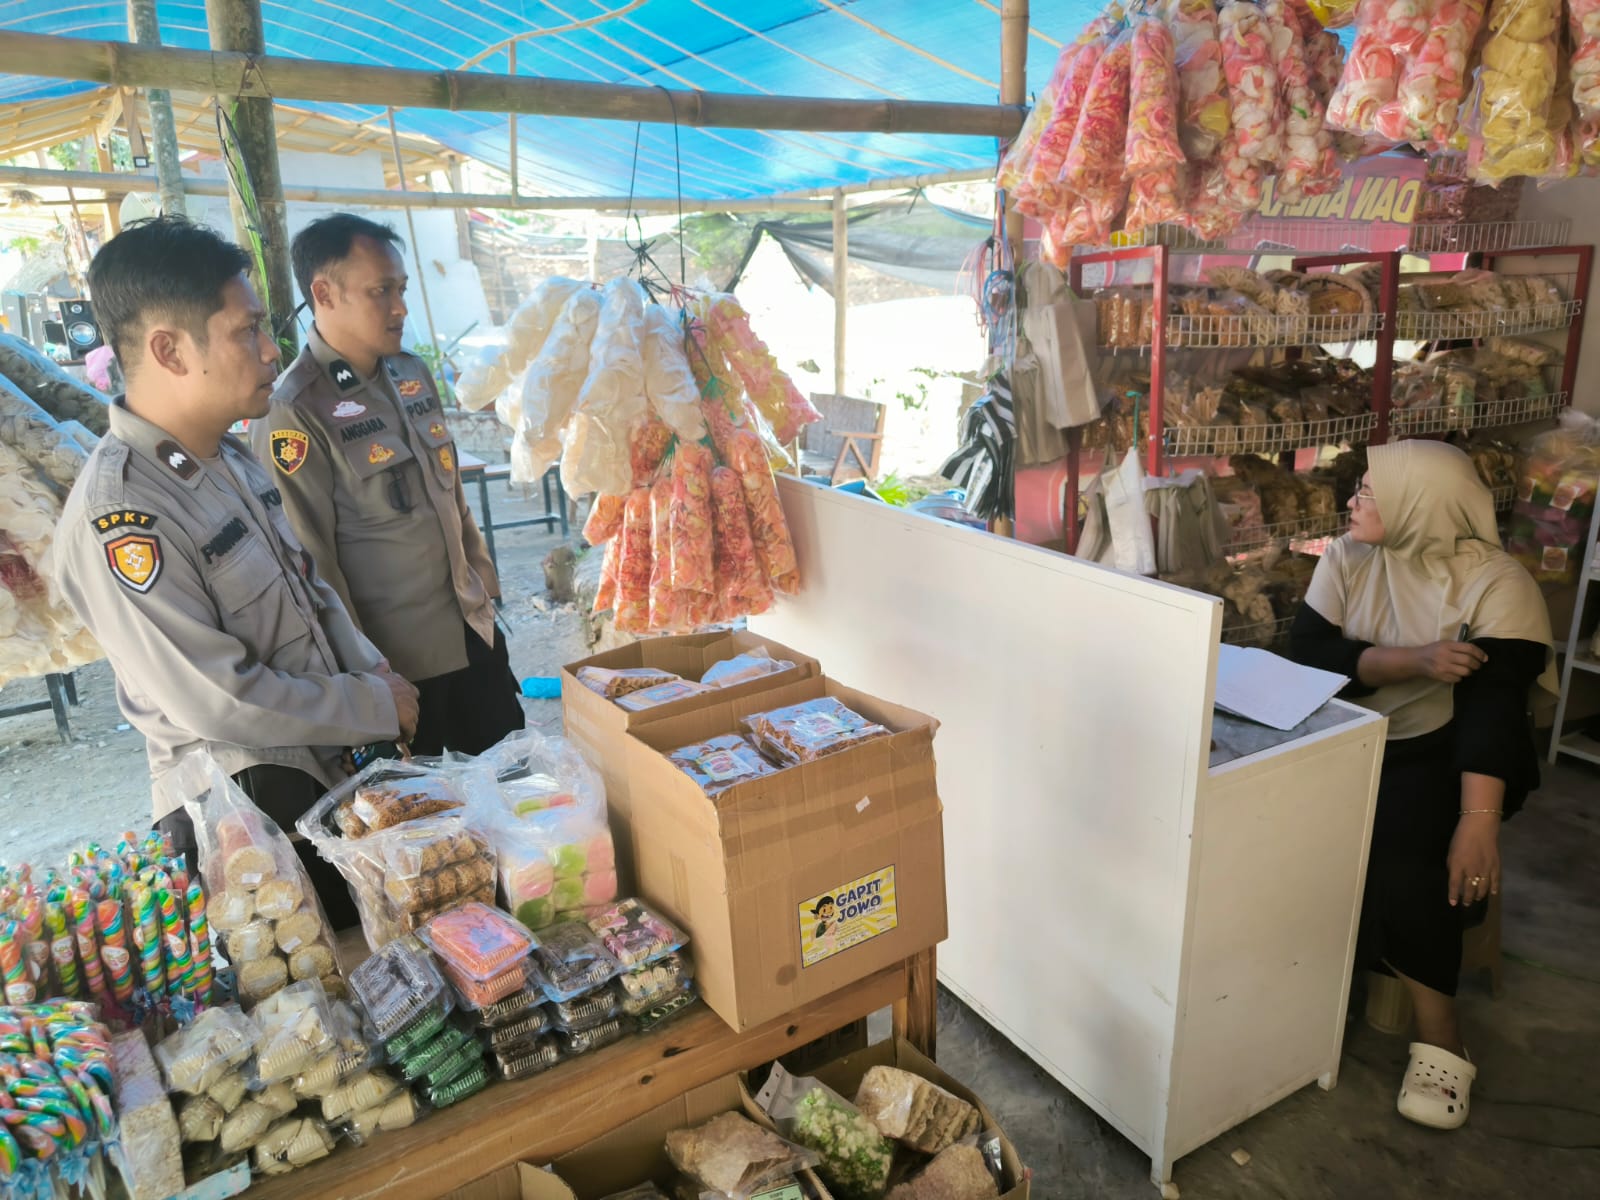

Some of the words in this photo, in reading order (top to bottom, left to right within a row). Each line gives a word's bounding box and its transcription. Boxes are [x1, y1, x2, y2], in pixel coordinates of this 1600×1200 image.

[340, 417, 387, 444] ANGGARA
[98, 512, 149, 530] SPKT
[835, 879, 881, 907] GAPIT
[837, 895, 881, 923] JOWO
